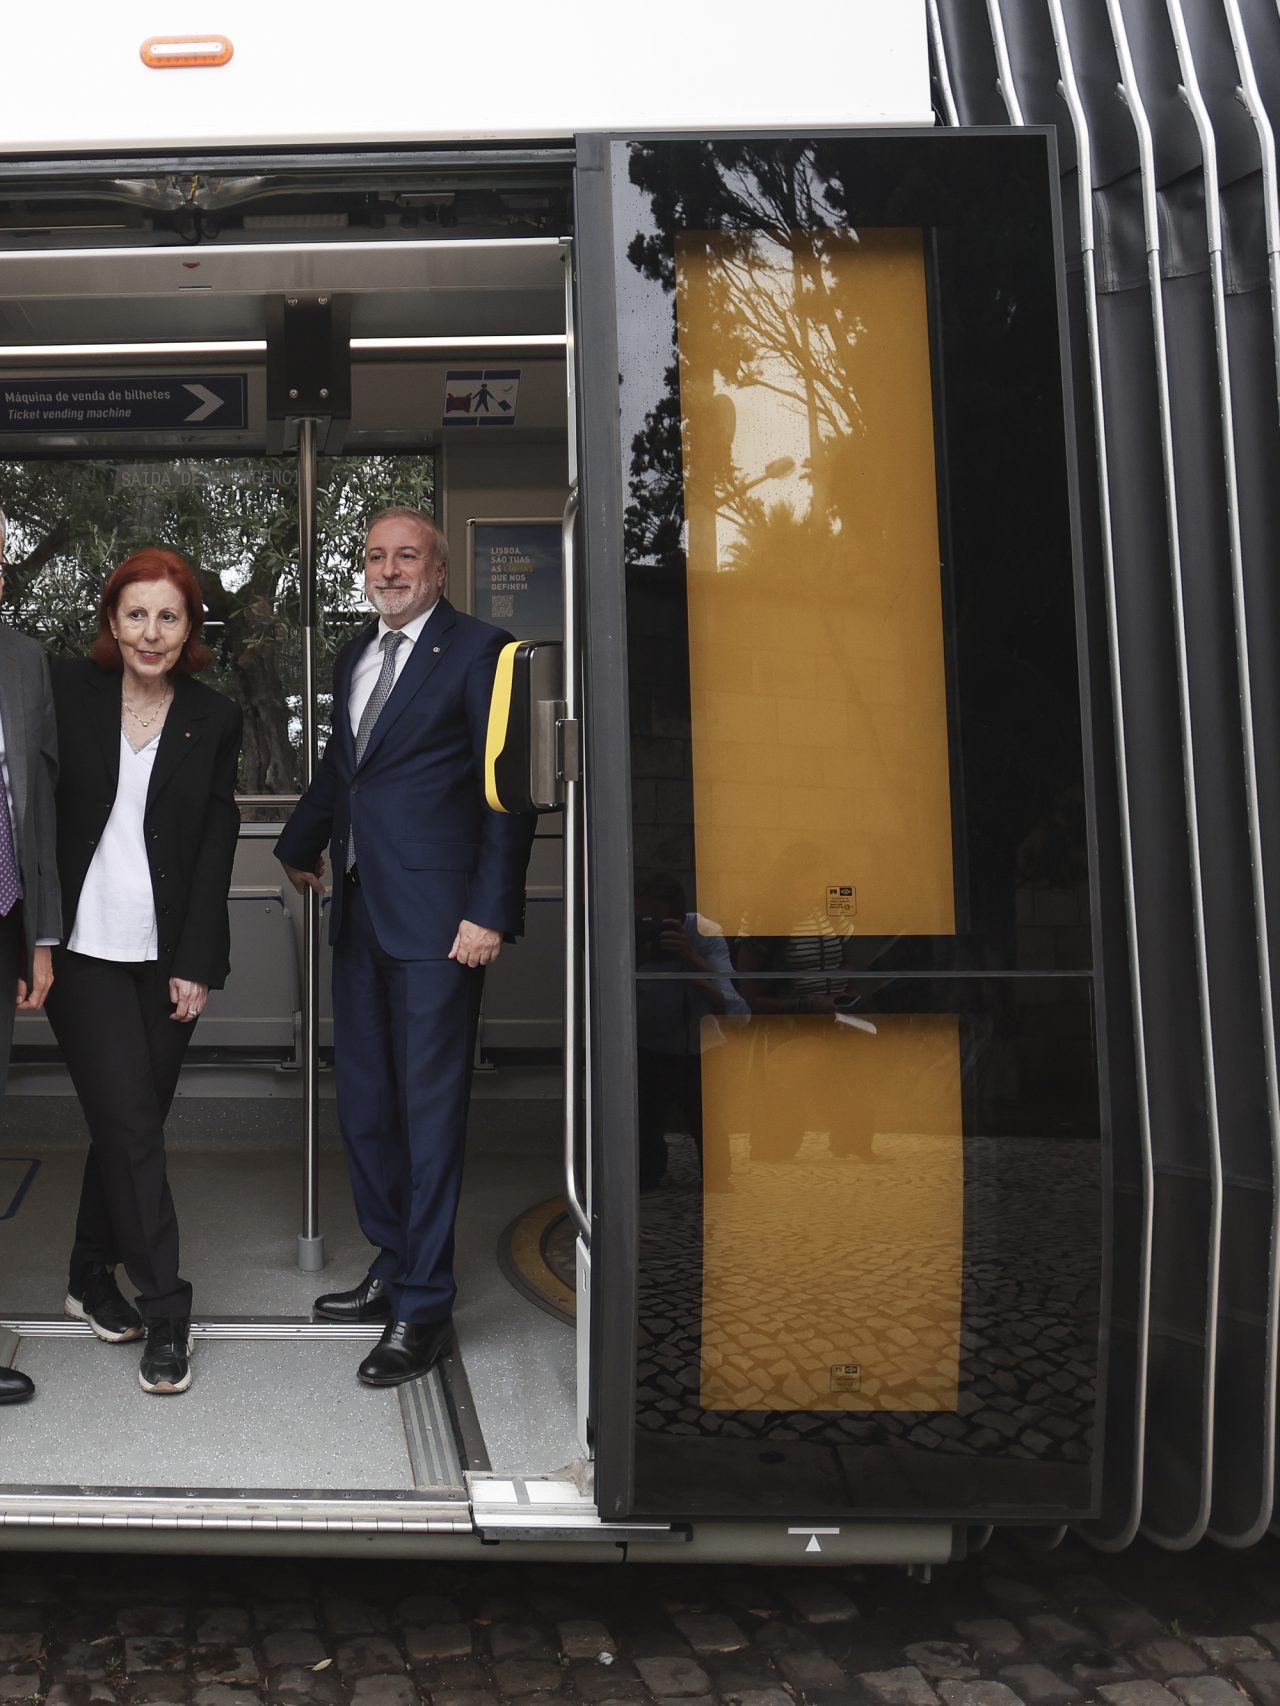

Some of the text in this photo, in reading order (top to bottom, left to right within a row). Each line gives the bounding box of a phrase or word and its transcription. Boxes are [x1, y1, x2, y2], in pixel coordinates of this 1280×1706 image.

[4, 389, 171, 405] Máquina de venda de bilhetes
[7, 407, 132, 421] Ticket vending machine
